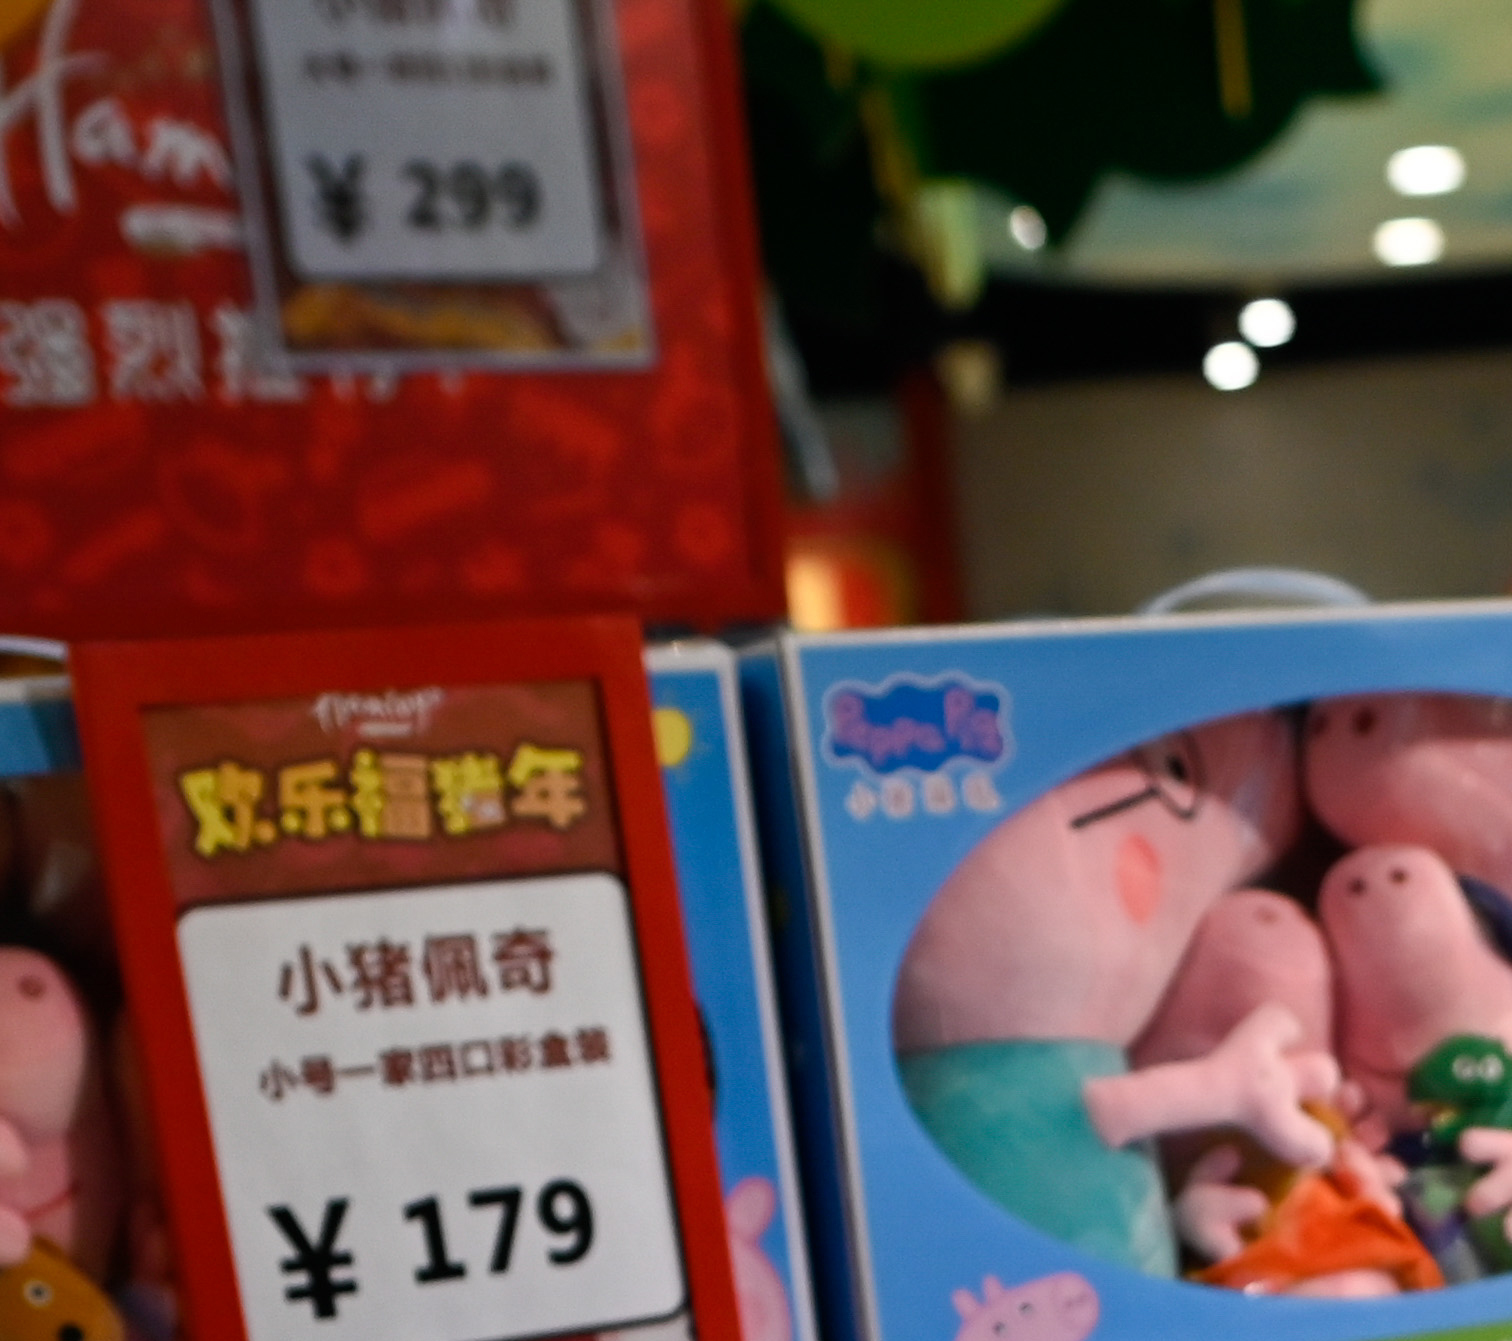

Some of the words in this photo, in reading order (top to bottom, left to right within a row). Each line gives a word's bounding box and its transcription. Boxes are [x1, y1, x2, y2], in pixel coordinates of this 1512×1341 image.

[402, 159, 544, 232] 299
[181, 743, 585, 856] 欢乐福猪年
[278, 928, 555, 1017] 小猪佩奇
[259, 1027, 612, 1101] 小号一家四口彩盒装
[268, 1198, 359, 1318] ¥
[404, 1178, 598, 1285] 179
